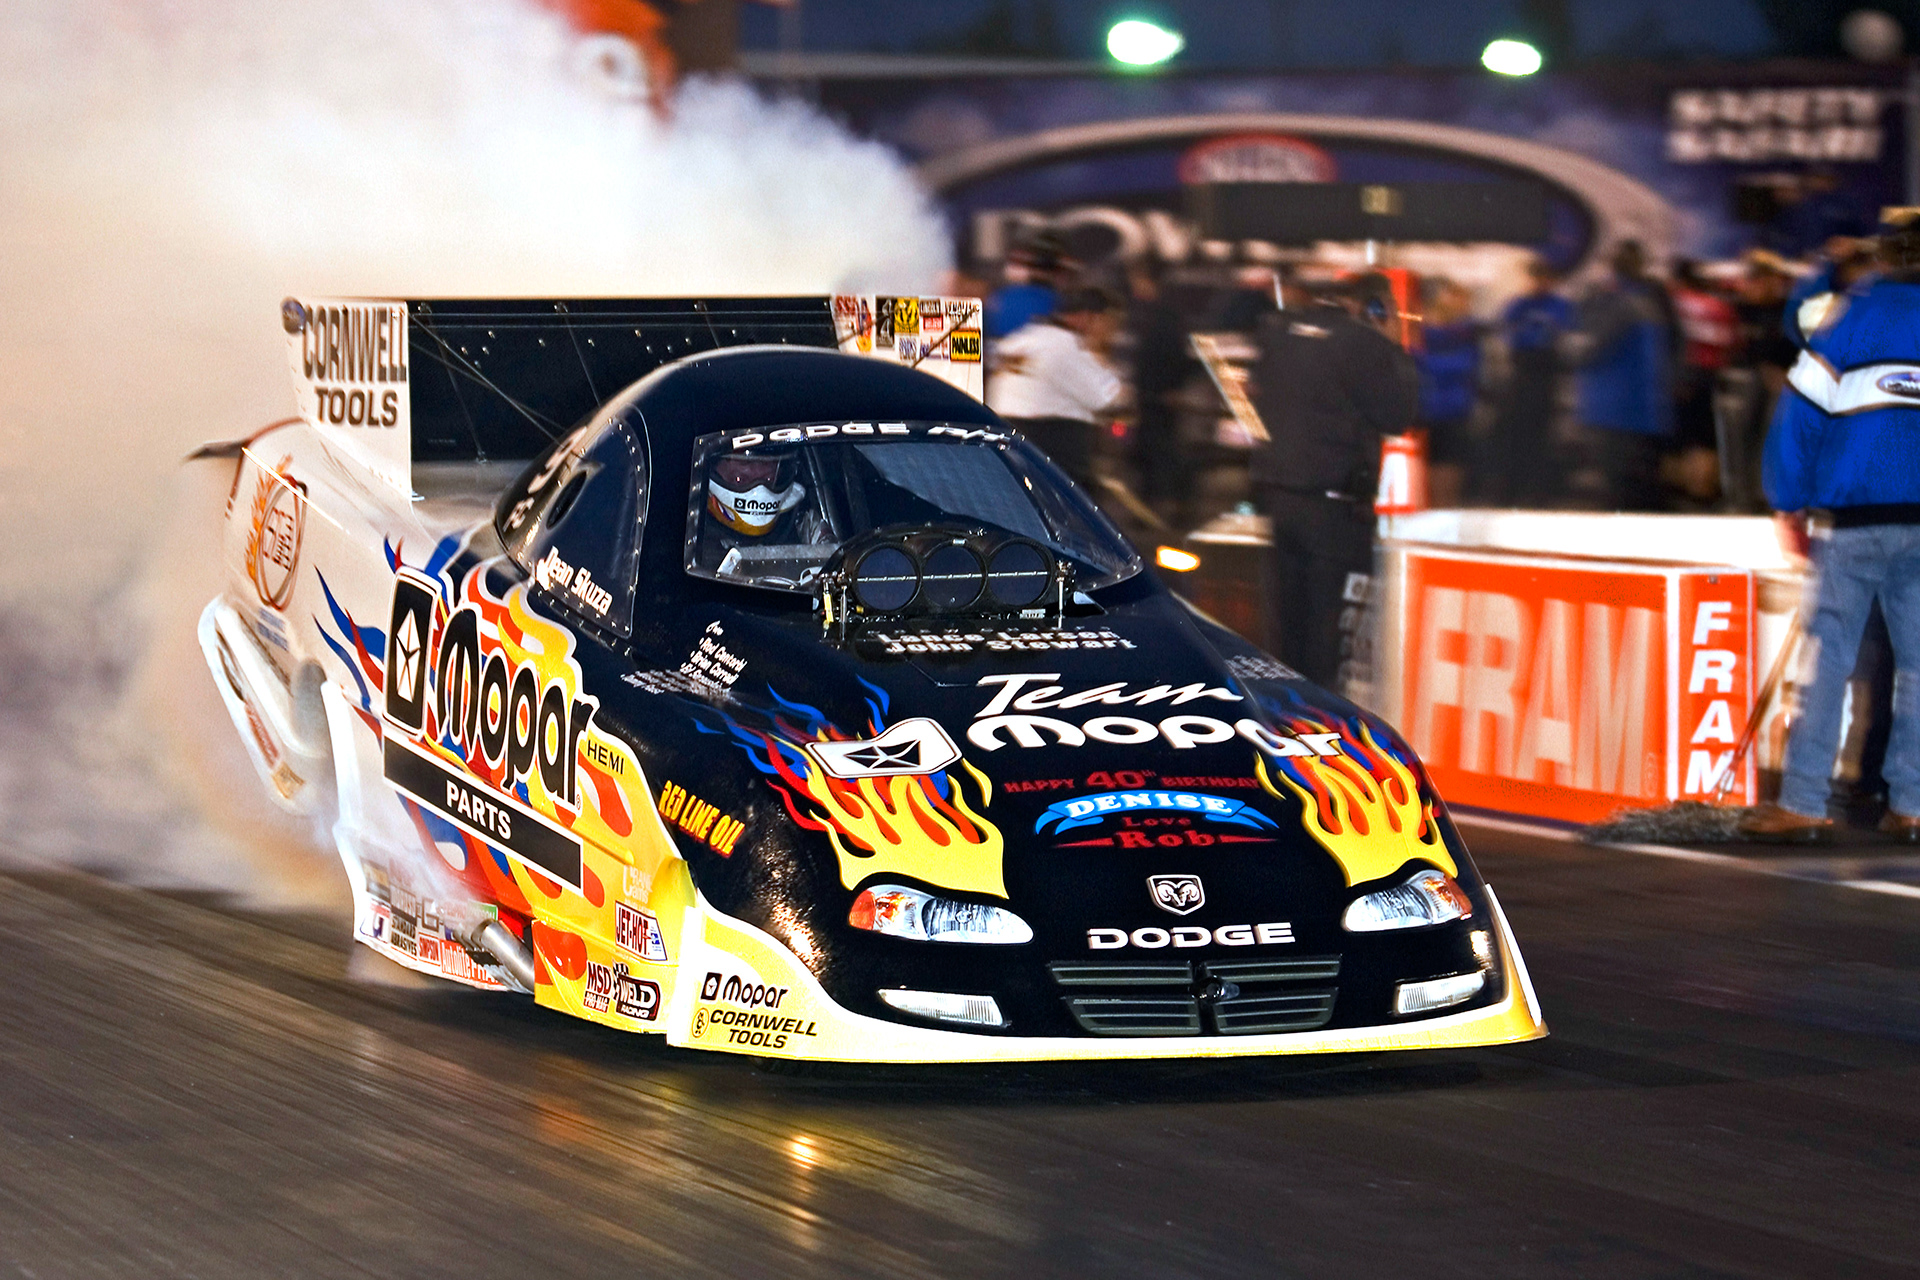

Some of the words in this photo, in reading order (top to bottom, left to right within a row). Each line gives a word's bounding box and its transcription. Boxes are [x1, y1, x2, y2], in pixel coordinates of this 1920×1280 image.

[303, 305, 407, 382] CORNWELL
[314, 386, 398, 427] TOOLS
[732, 422, 910, 450] DODGE
[538, 546, 575, 591] Dean
[571, 566, 614, 616] Skuza
[877, 633, 985, 643] Lance
[997, 631, 1121, 641] Larsen
[886, 640, 974, 654] John
[986, 638, 1138, 650] Stewart
[436, 607, 594, 807] Mopar
[974, 672, 1245, 718] Team
[1412, 584, 1665, 799] FRAM
[1684, 601, 1737, 796] FRAM
[966, 714, 1343, 757] Mopar
[587, 739, 625, 775] HEMI
[1003, 779, 1075, 793] HAPPY
[1160, 776, 1260, 788] BIRTHDAY
[446, 779, 512, 840] PARTS
[658, 780, 687, 823] RED
[679, 794, 721, 842] LINE
[709, 814, 746, 858] OIL
[1064, 792, 1233, 818] DENISE
[1121, 816, 1192, 827] Love
[1116, 829, 1216, 849] Rob
[419, 936, 440, 962] SIMPSON
[1087, 921, 1296, 950] DODGE
[441, 942, 471, 979] Autolite
[587, 961, 612, 995] MSD
[620, 978, 657, 1009] WELD
[722, 974, 788, 1009] Mopar
[620, 1004, 650, 1019] RACING
[710, 1009, 818, 1037] CORNWELL
[728, 1028, 788, 1049] TOOLS
